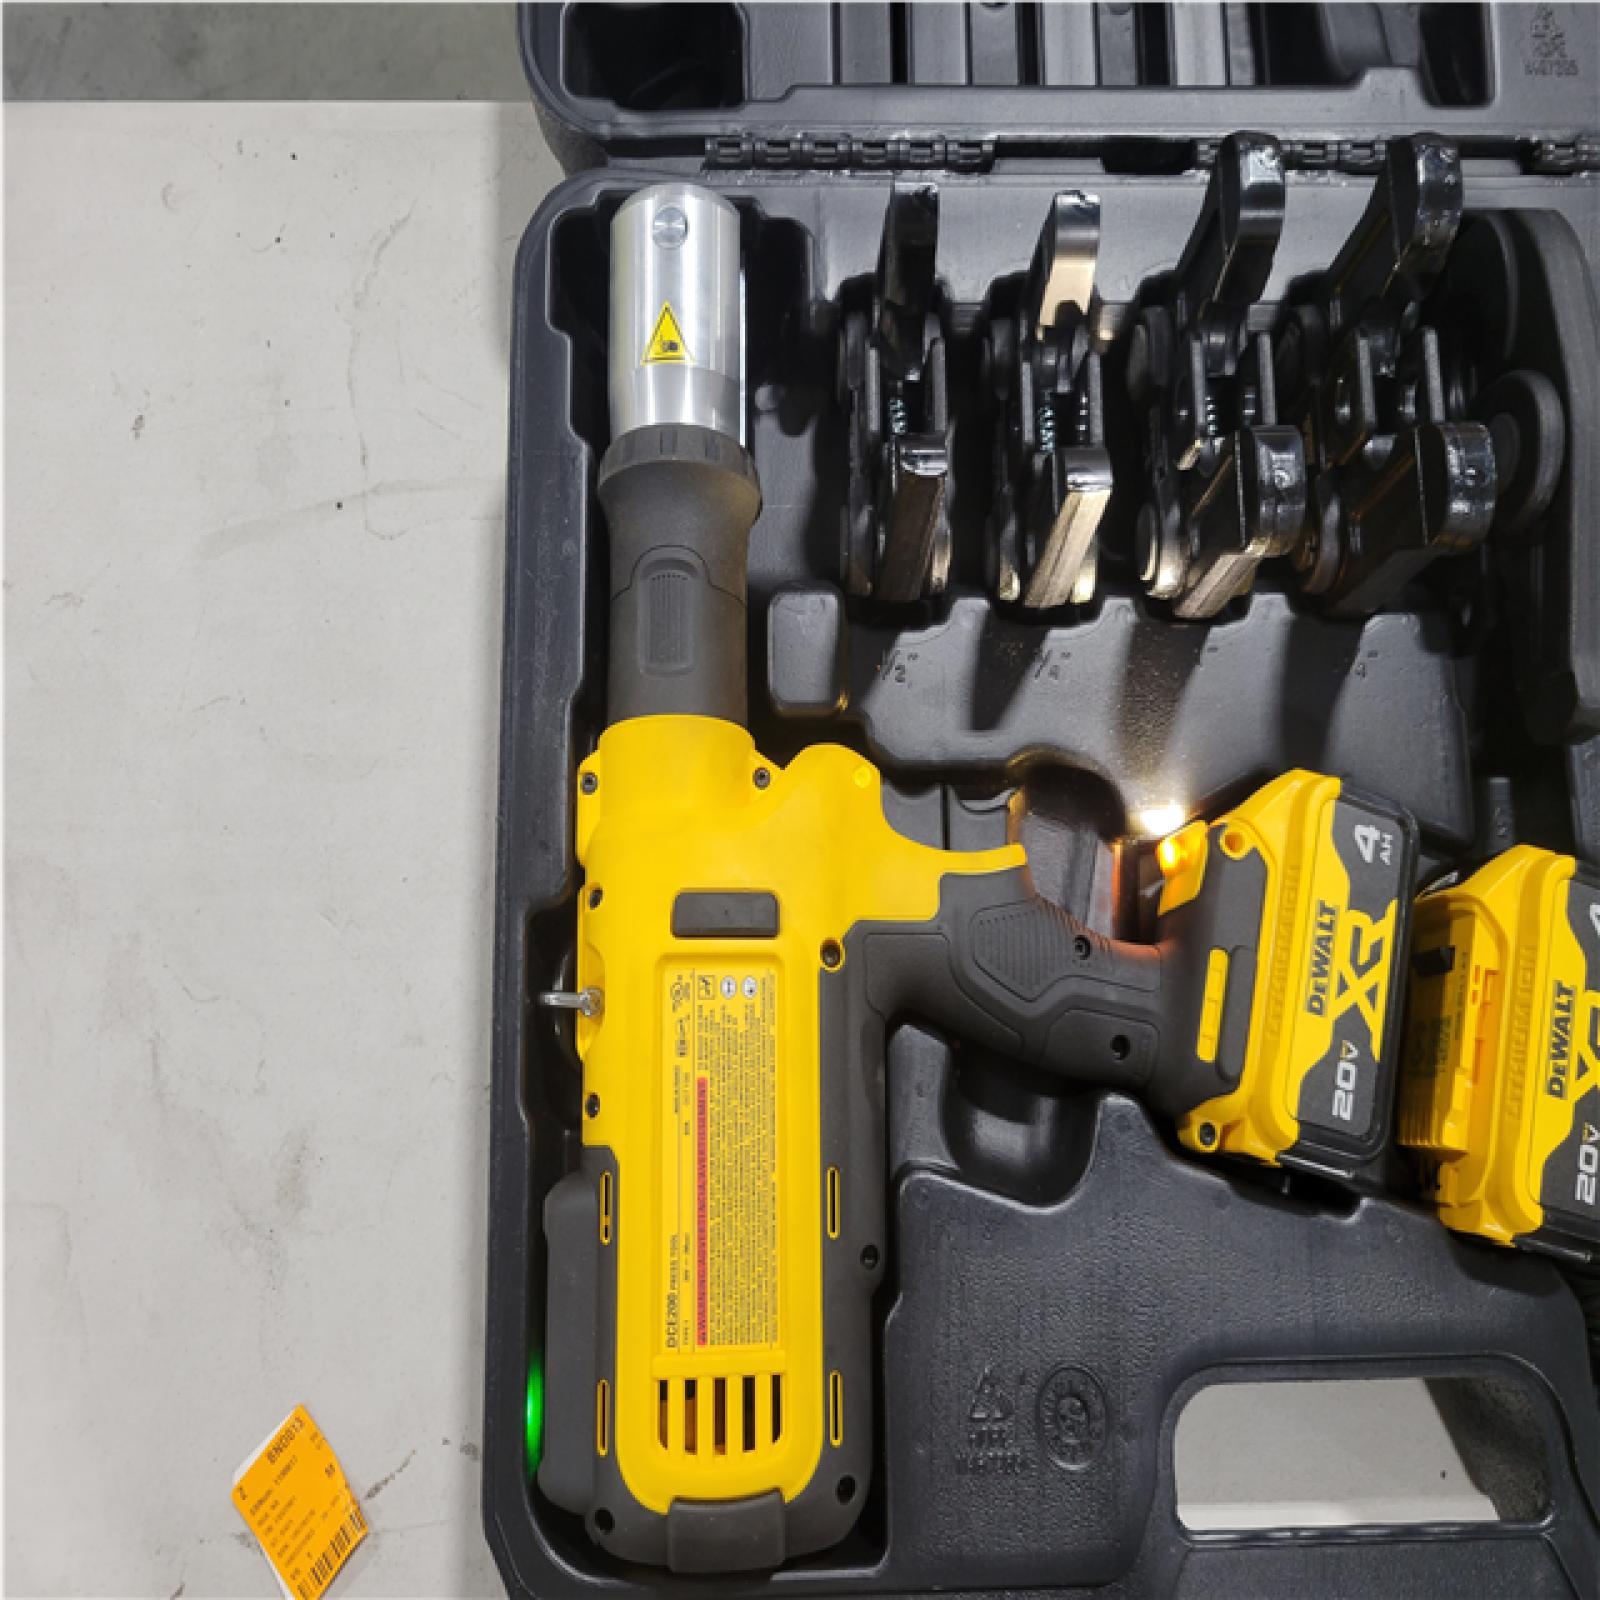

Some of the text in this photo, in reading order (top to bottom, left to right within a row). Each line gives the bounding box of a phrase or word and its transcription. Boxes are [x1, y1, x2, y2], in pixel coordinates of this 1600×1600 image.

[1354, 825, 1380, 864] 4
[1306, 900, 1337, 1016] DEWALT
[1549, 980, 1577, 1099] DEWALT
